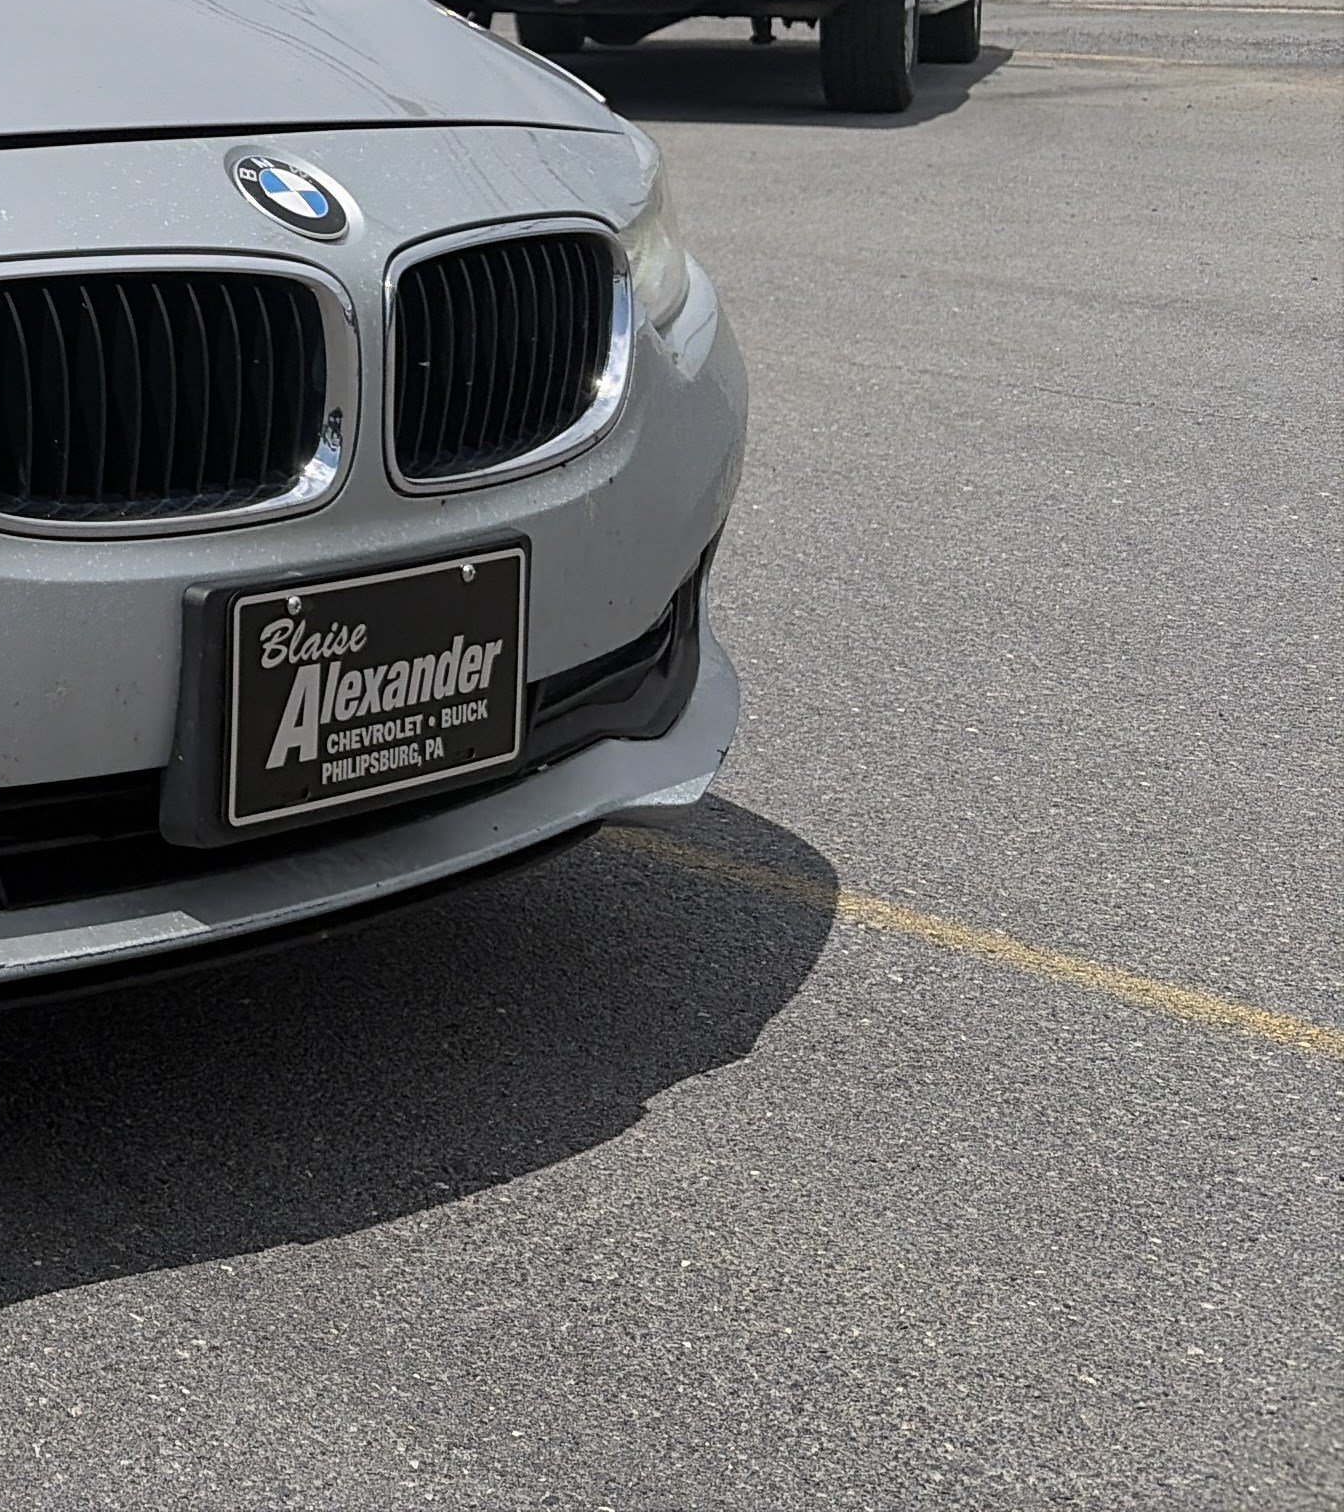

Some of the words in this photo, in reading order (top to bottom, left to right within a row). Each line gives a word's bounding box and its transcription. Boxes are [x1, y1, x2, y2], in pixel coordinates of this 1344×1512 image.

[259, 617, 368, 670] Blaise
[264, 634, 504, 770] Alexander
[326, 713, 423, 755] CHEVROLET
[441, 698, 488, 730] BUICK
[320, 743, 423, 787] PHILIPSBURG,
[425, 736, 444, 761] PA
